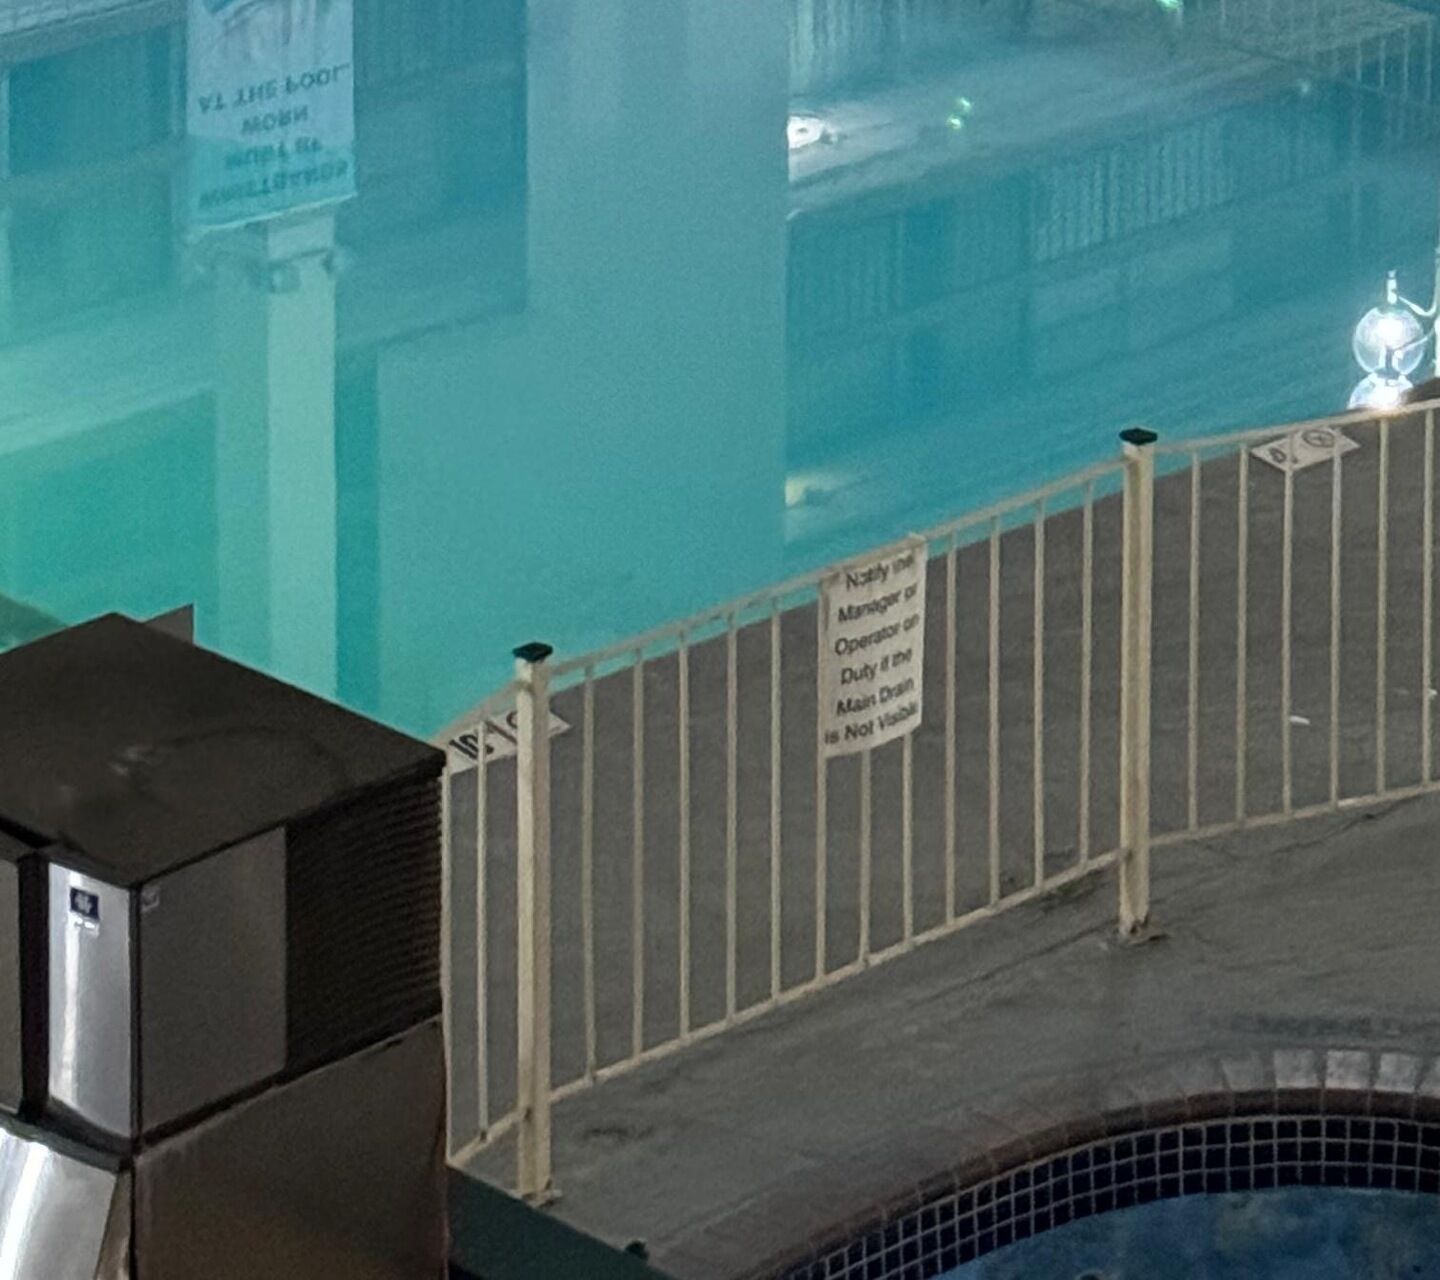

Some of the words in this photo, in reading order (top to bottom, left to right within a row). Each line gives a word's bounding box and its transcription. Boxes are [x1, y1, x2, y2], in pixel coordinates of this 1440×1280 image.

[845, 562, 890, 590] Notify
[838, 590, 902, 624] Manager
[835, 621, 900, 657] Operator
[903, 612, 920, 632] on
[840, 661, 878, 686] Duty
[836, 697, 878, 719] Main
[878, 677, 915, 705] Drain
[844, 718, 875, 742] Not
